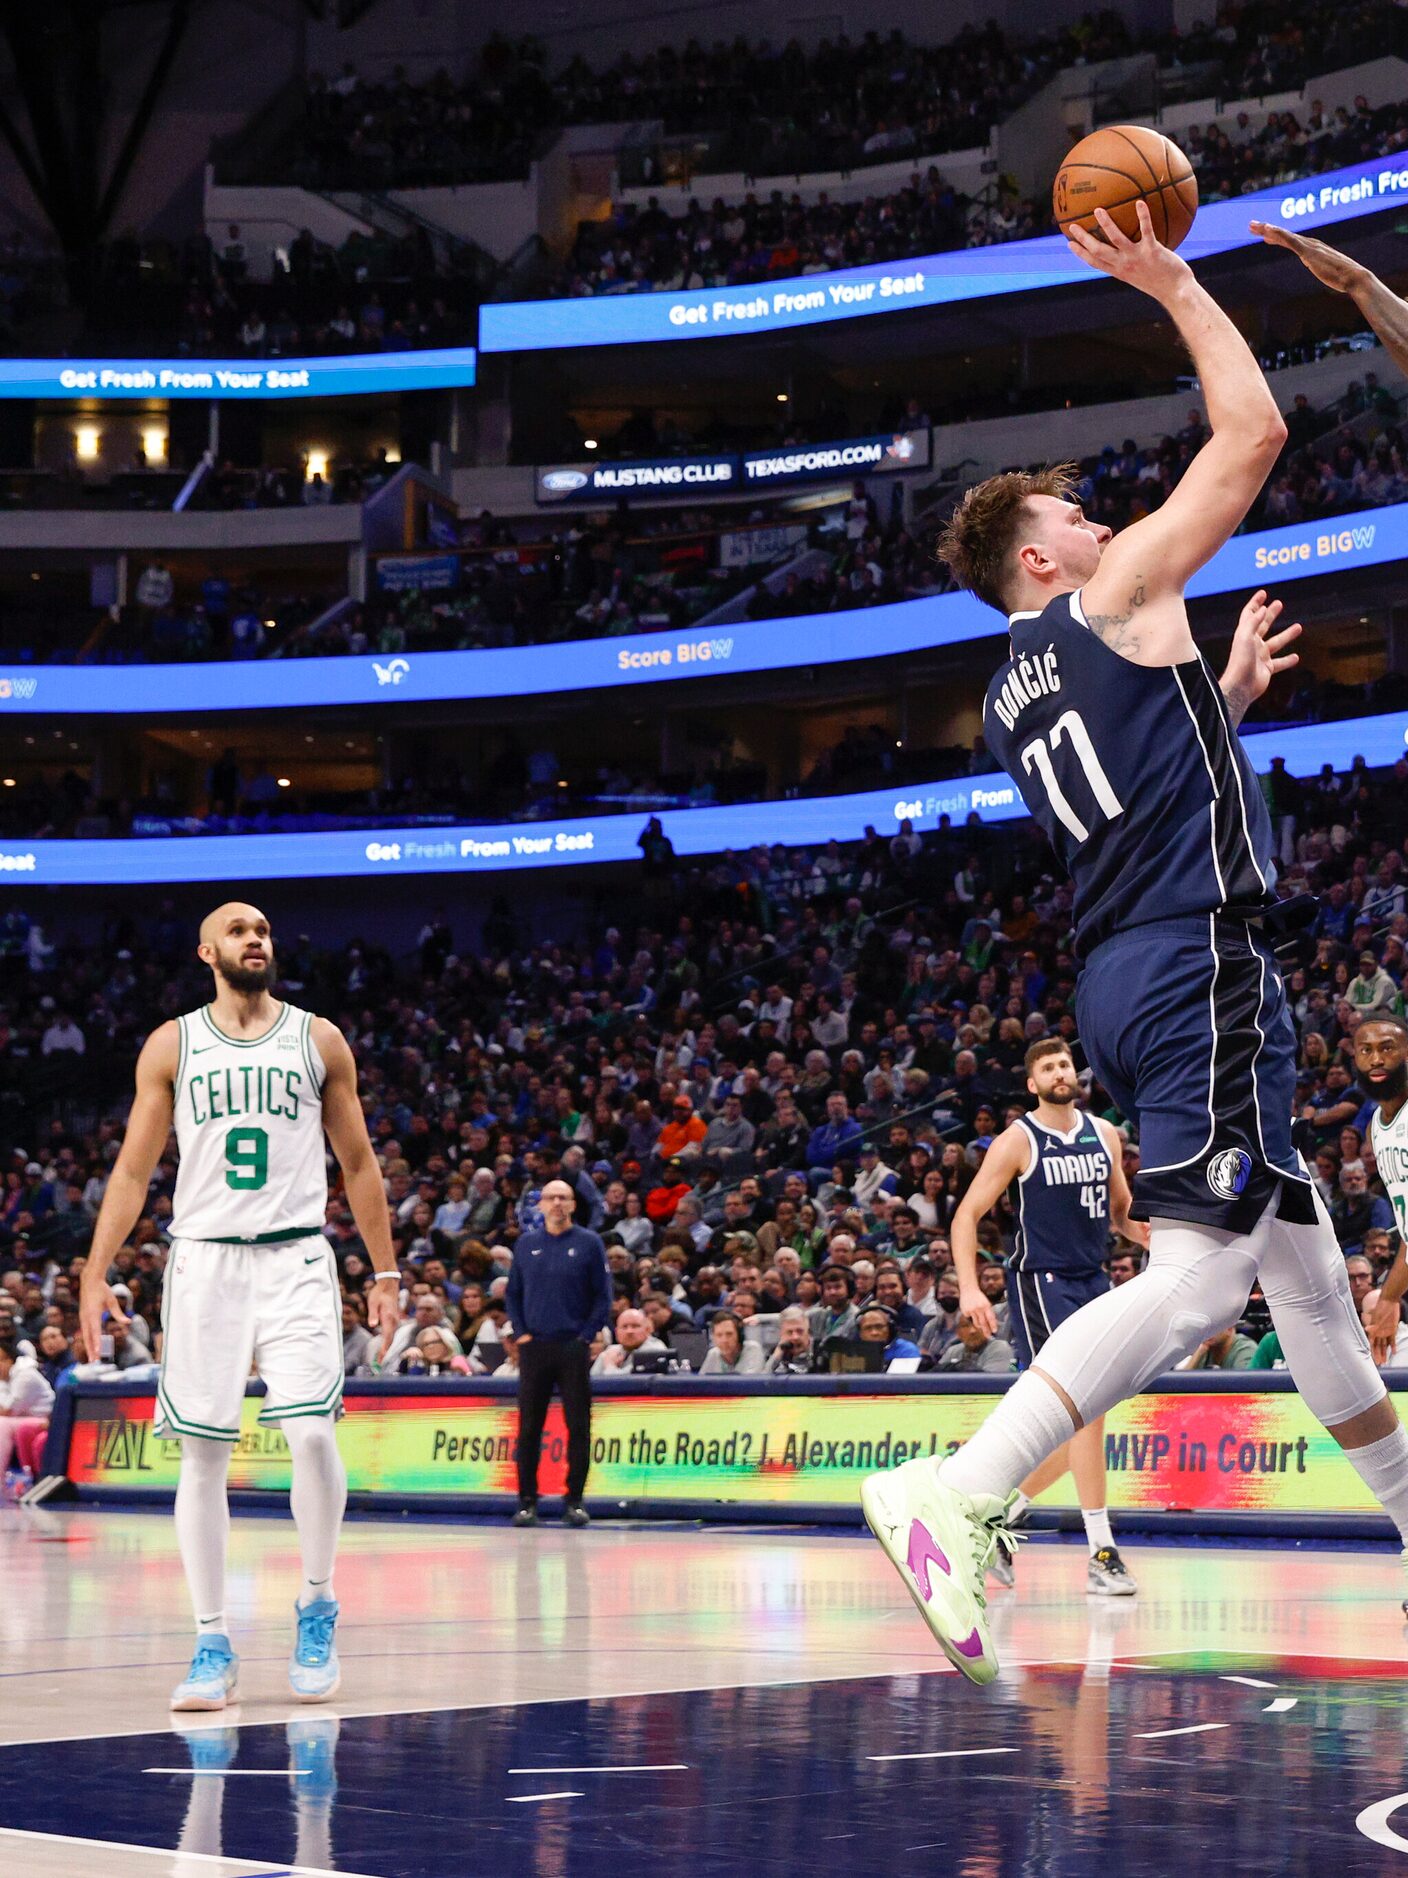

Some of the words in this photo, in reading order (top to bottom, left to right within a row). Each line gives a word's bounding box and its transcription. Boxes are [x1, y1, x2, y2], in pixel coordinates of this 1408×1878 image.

[1281, 193, 1315, 219] Get
[1320, 177, 1374, 209] Fresh
[669, 305, 707, 325] Get
[712, 297, 769, 322] Fresh
[773, 289, 825, 314] From
[829, 282, 876, 306] Your
[879, 273, 925, 297] Seat
[59, 370, 97, 388] Get
[100, 370, 156, 388] Fresh
[159, 370, 213, 388] From
[215, 371, 263, 388] Your
[266, 370, 310, 388] Seat
[594, 465, 682, 487] MUSTANG
[683, 462, 732, 482] CLUB
[745, 443, 882, 478] TEXASFORD.COM
[1255, 543, 1311, 568] Score
[1317, 525, 1376, 557] BIGW
[618, 649, 672, 669] Score
[677, 638, 734, 663] BIGW
[993, 642, 1061, 732] DONČIĆ
[1020, 709, 1125, 843] 77
[894, 799, 923, 820] Get
[925, 792, 968, 815] Fresh
[971, 788, 1013, 809] From
[366, 842, 401, 861] Get
[405, 841, 457, 859] Fresh
[460, 839, 511, 858] From
[512, 836, 553, 855] Your
[555, 831, 594, 852] Seat
[189, 1066, 302, 1126] CELTICS
[224, 1127, 268, 1190] 9
[1080, 1184, 1107, 1219] 42
[1392, 1194, 1408, 1243] 7
[433, 1429, 520, 1463] Person
[540, 1430, 564, 1463] Fo
[593, 1437, 620, 1464] on
[629, 1430, 666, 1465] the
[674, 1431, 752, 1467] Road?
[758, 1433, 774, 1464] J.
[782, 1431, 921, 1469] Alexander
[1104, 1433, 1170, 1471] MVP
[1178, 1432, 1207, 1473] in
[1217, 1433, 1309, 1474] Court
